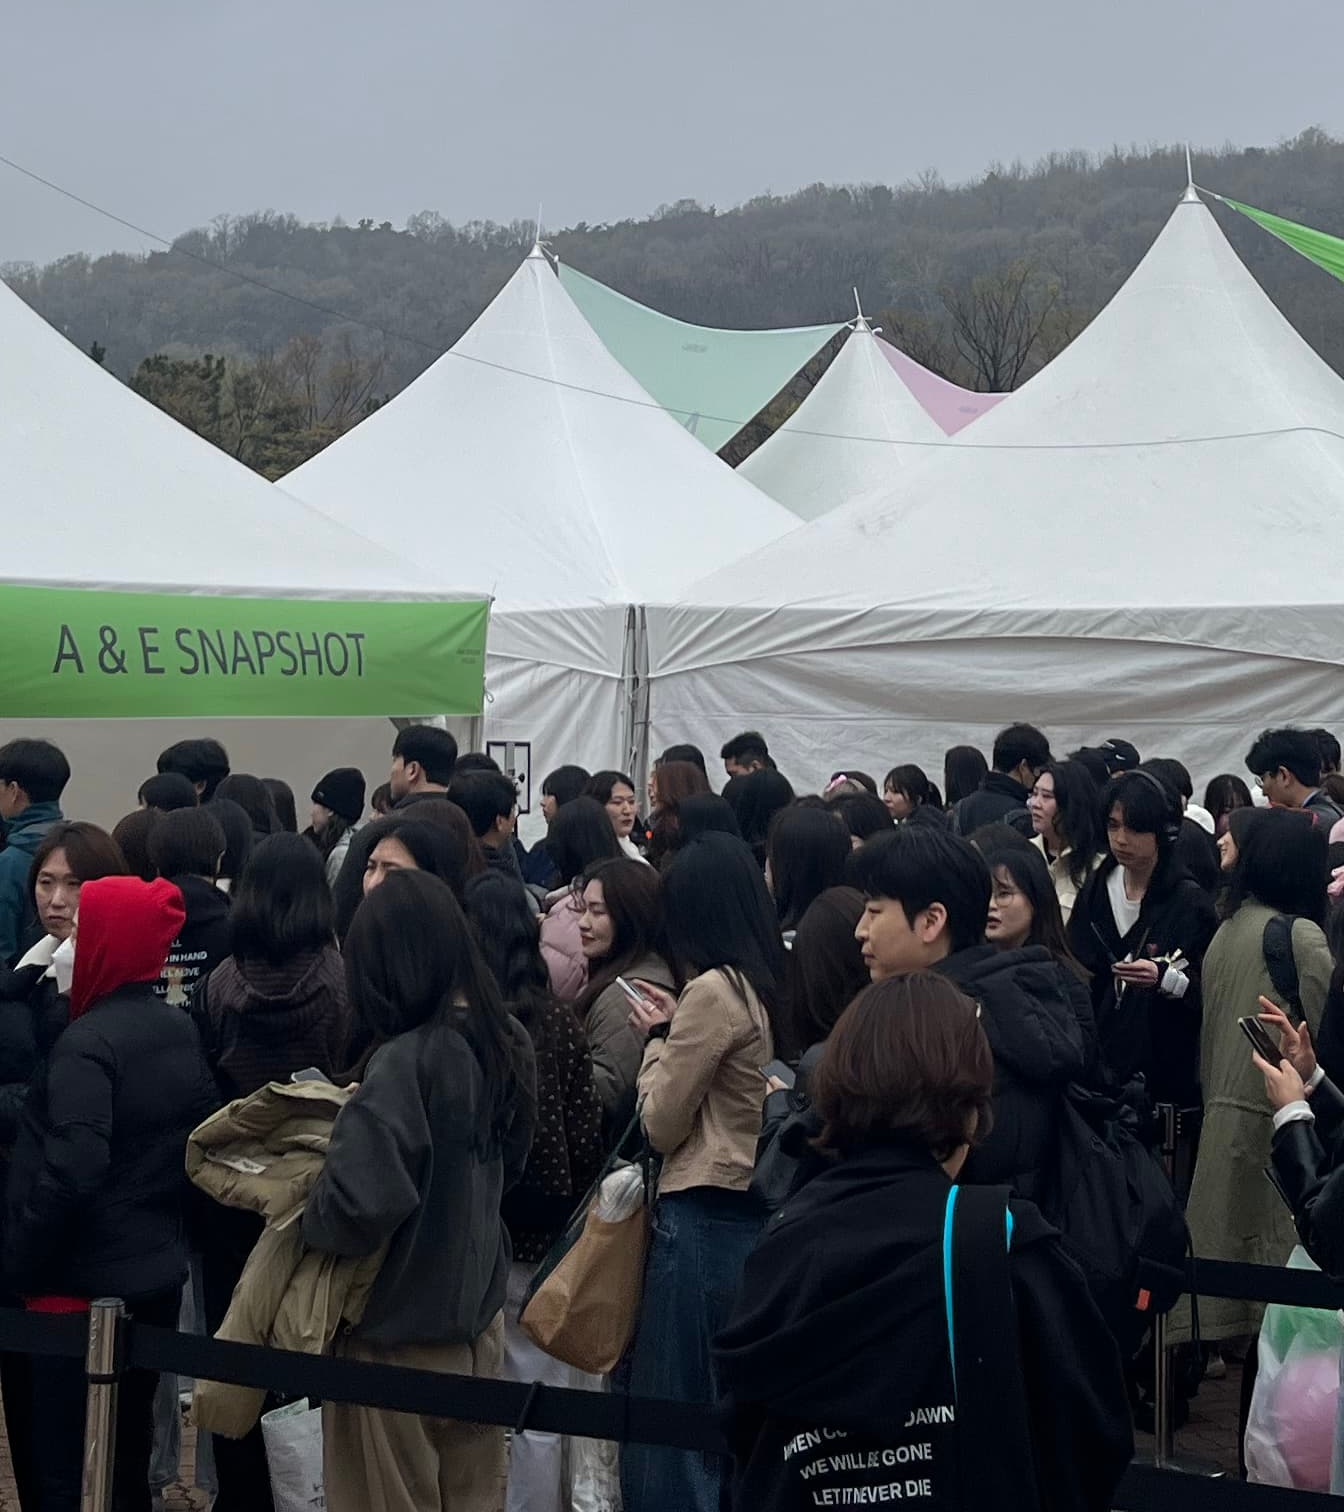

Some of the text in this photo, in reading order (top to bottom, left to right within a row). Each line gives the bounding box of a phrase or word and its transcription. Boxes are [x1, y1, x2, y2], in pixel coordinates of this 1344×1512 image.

[53, 624, 365, 677] A & E SNAPSHOT
[169, 954, 180, 963] IN
[180, 951, 208, 962] HAND
[799, 1458, 830, 1480] WE
[829, 1452, 866, 1472] WILL
[882, 1443, 933, 1467] GONE
[812, 1479, 932, 1506] LET IT NEVER DIE
